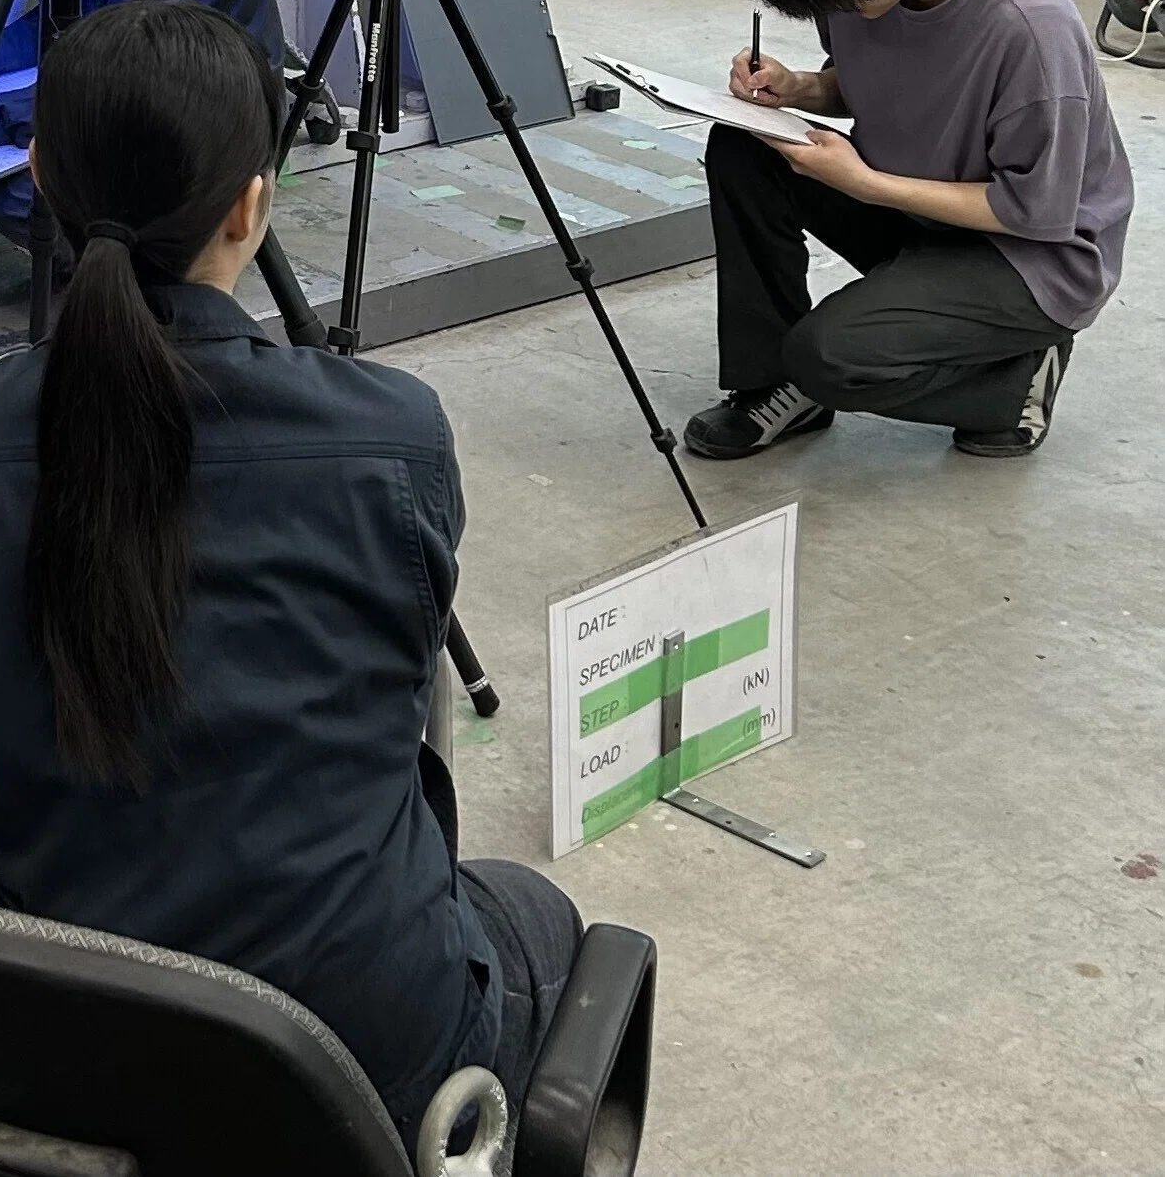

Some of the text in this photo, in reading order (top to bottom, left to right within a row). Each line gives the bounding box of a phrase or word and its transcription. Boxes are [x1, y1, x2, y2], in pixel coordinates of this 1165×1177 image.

[367, 22, 381, 83] Manfrotto
[743, 668, 770, 696] (kN)
[743, 707, 776, 737] (mm)
